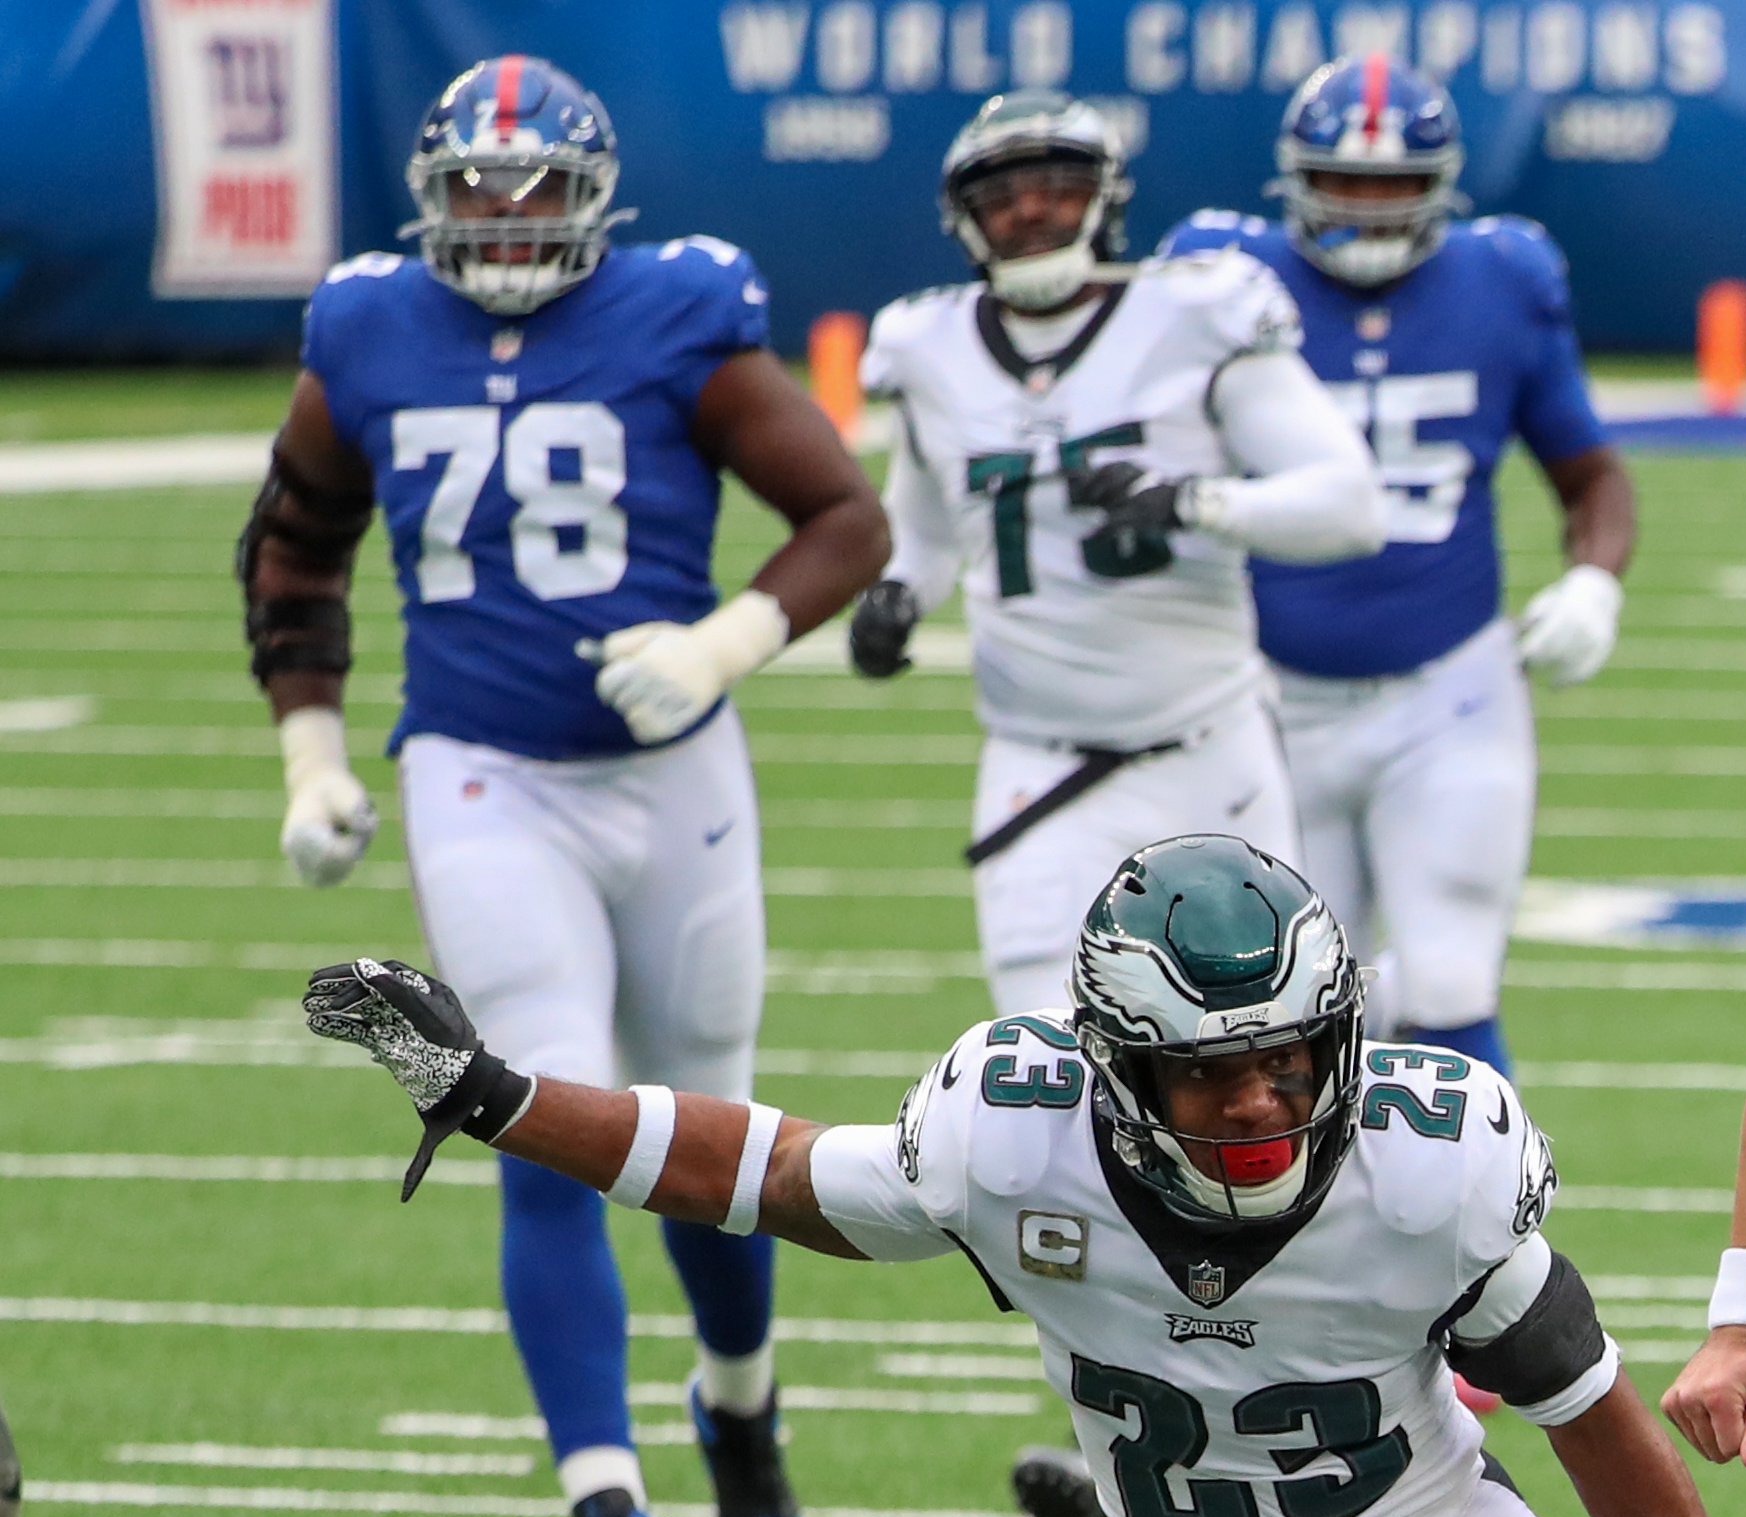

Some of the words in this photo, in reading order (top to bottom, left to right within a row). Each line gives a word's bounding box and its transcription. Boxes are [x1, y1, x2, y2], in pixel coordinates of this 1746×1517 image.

[720, 2, 1073, 93] WORLD
[1125, 2, 1726, 94] CHAMPIONS
[391, 401, 628, 604] 78
[981, 1015, 1085, 1109] 23
[1362, 1045, 1474, 1142] 23
[1022, 1215, 1082, 1266] C
[1169, 1314, 1257, 1349] EAGLES
[1193, 1280, 1220, 1300] NFL
